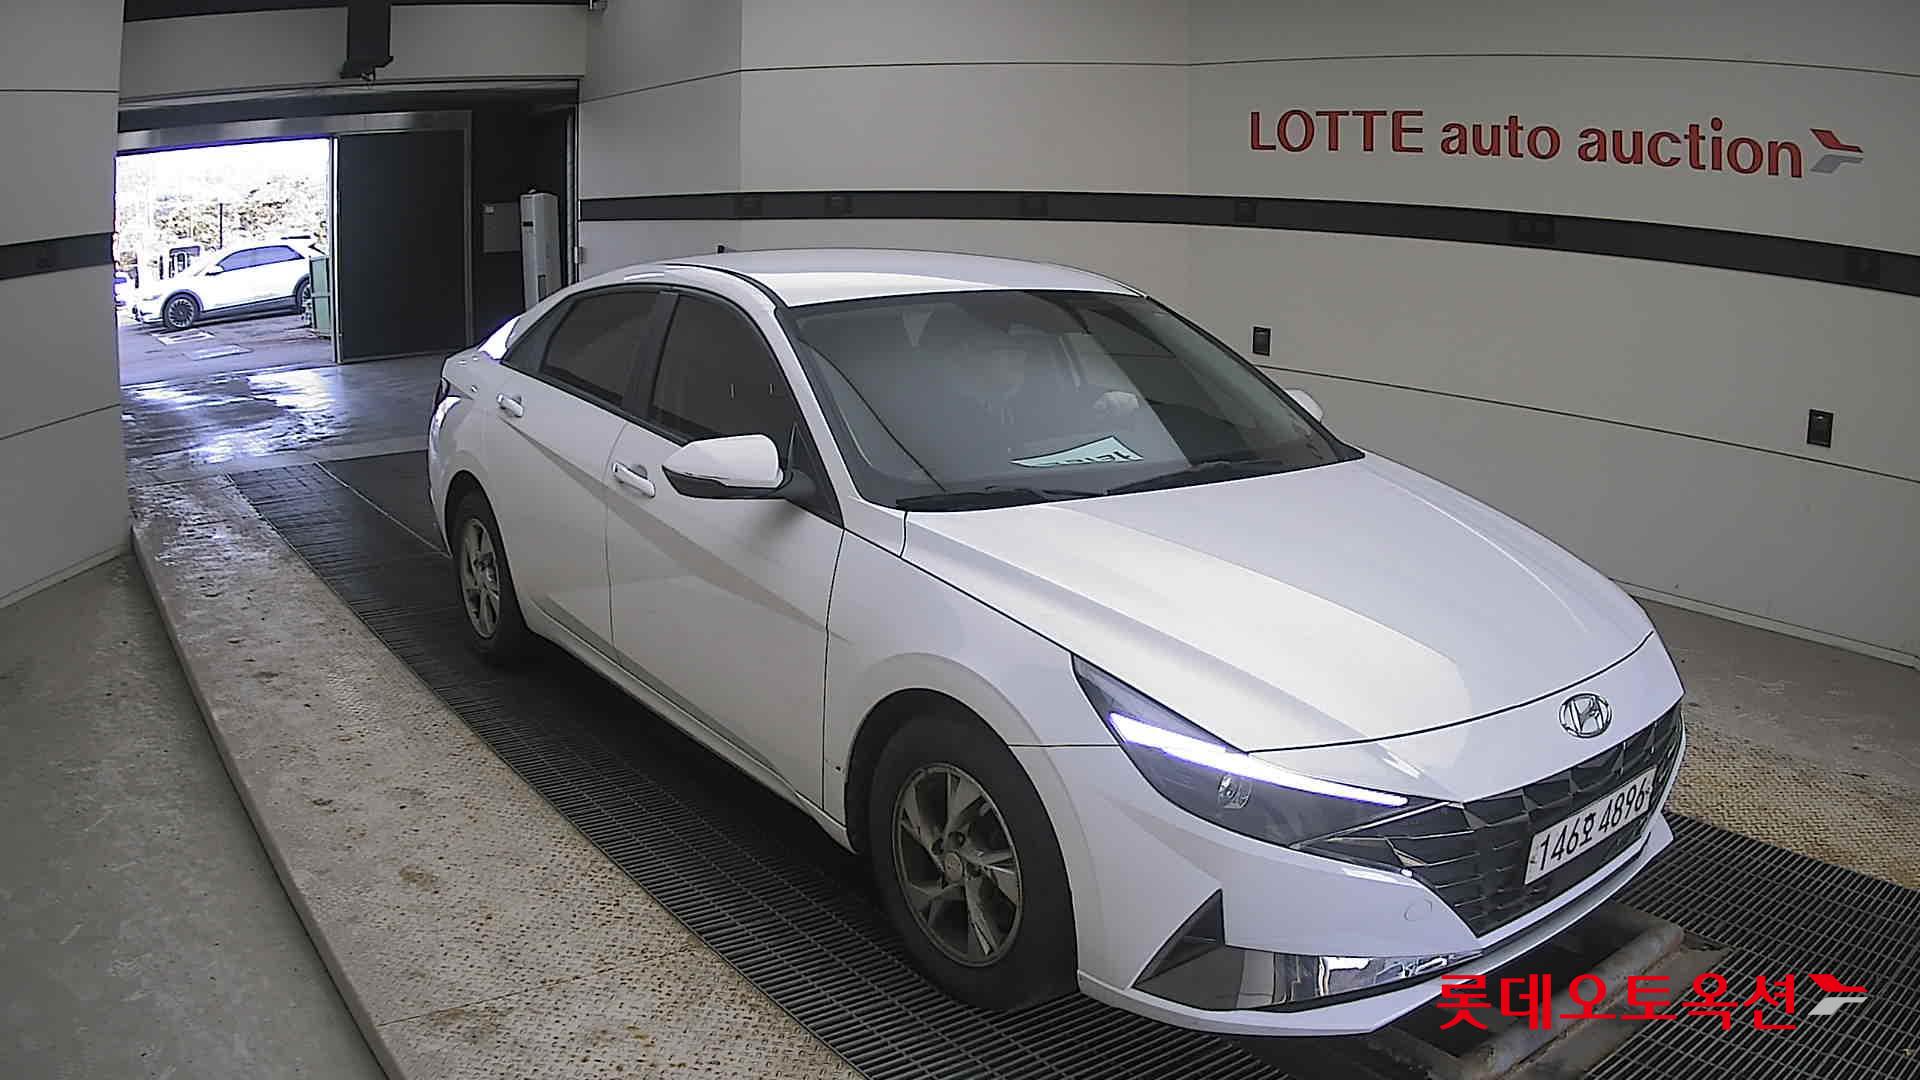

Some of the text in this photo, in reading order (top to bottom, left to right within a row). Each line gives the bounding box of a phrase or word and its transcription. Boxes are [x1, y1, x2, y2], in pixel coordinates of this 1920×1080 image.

[1250, 109, 1804, 177] LOTTE auto auction
[1540, 777, 1647, 870] 146호 4896
